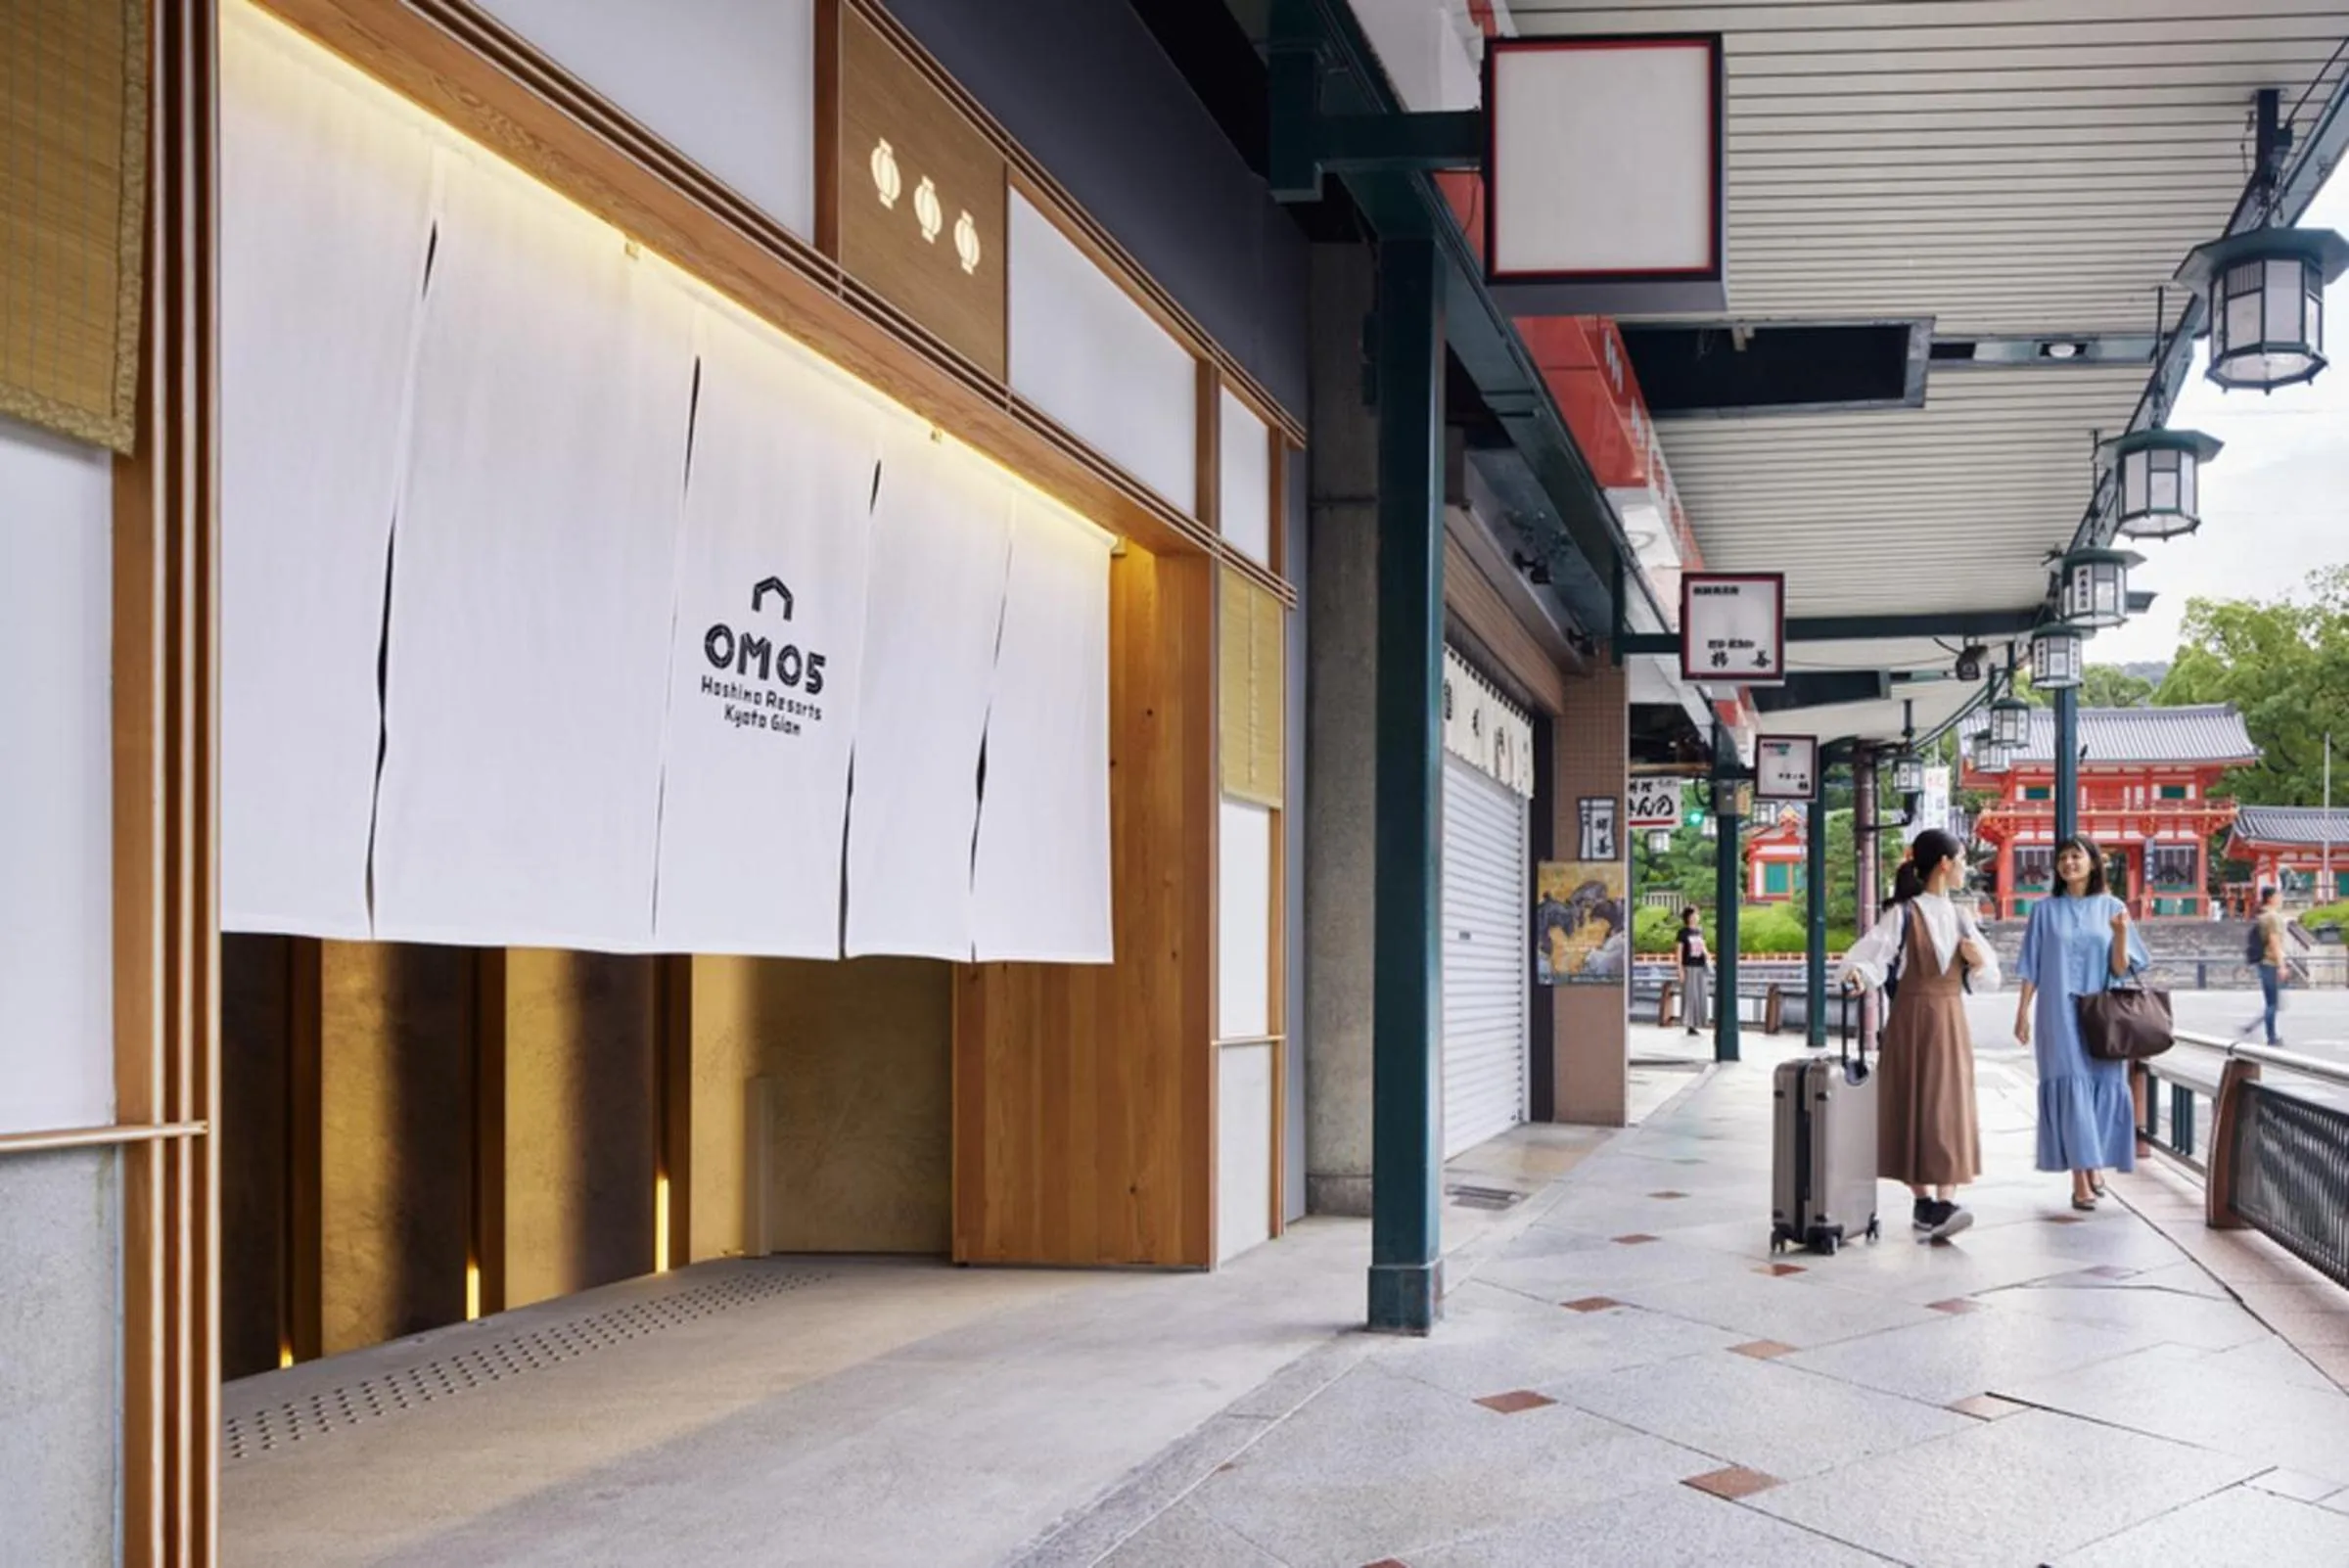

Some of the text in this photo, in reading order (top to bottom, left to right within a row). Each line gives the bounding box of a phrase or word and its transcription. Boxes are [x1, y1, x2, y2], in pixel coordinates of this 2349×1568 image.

[704, 623, 826, 695] OMO5
[701, 675, 822, 720] Hoshino Resorts
[724, 705, 801, 736] Kyoto Gion
